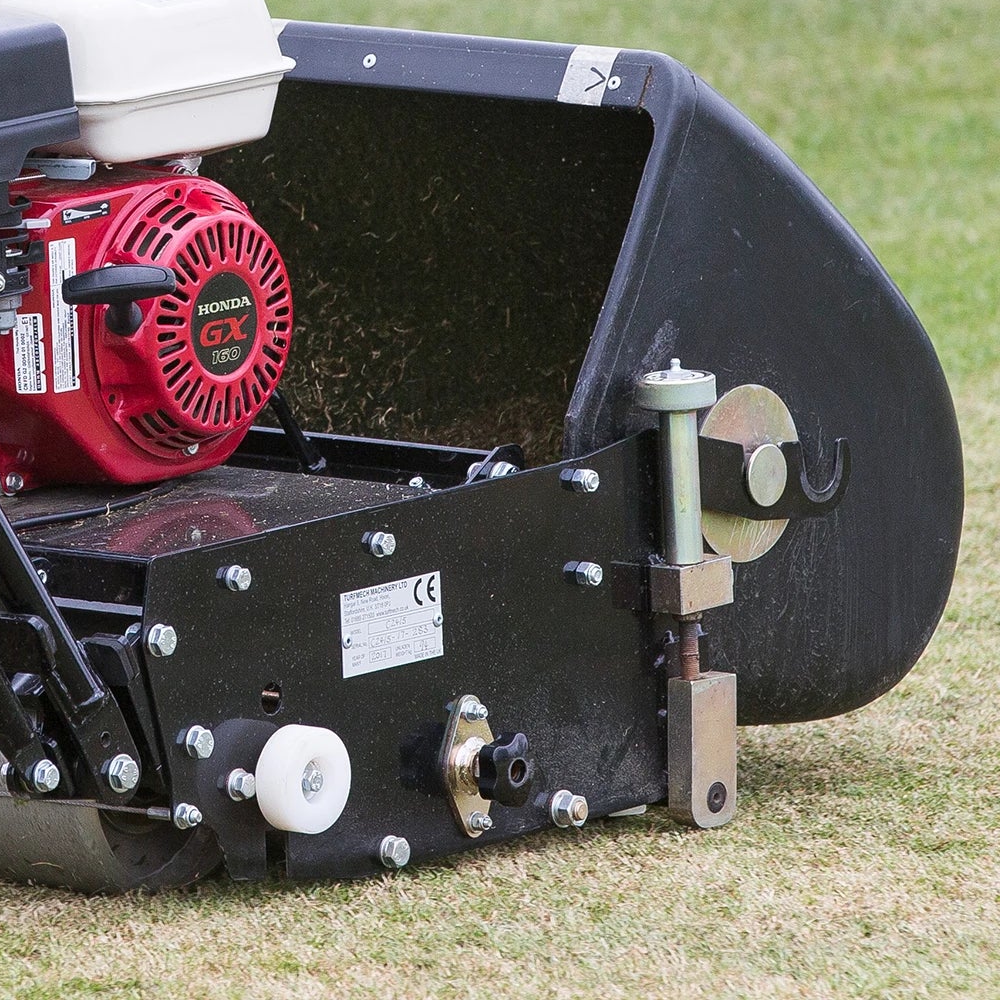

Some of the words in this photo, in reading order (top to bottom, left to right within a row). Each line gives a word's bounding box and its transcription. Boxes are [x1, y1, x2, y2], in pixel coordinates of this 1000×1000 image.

[198, 296, 252, 316] HONDA
[21, 316, 28, 324] E1
[200, 313, 250, 347] GX
[212, 346, 241, 365] 160
[344, 590, 369, 601] TURFMECH
[370, 583, 398, 595] MACHINERY
